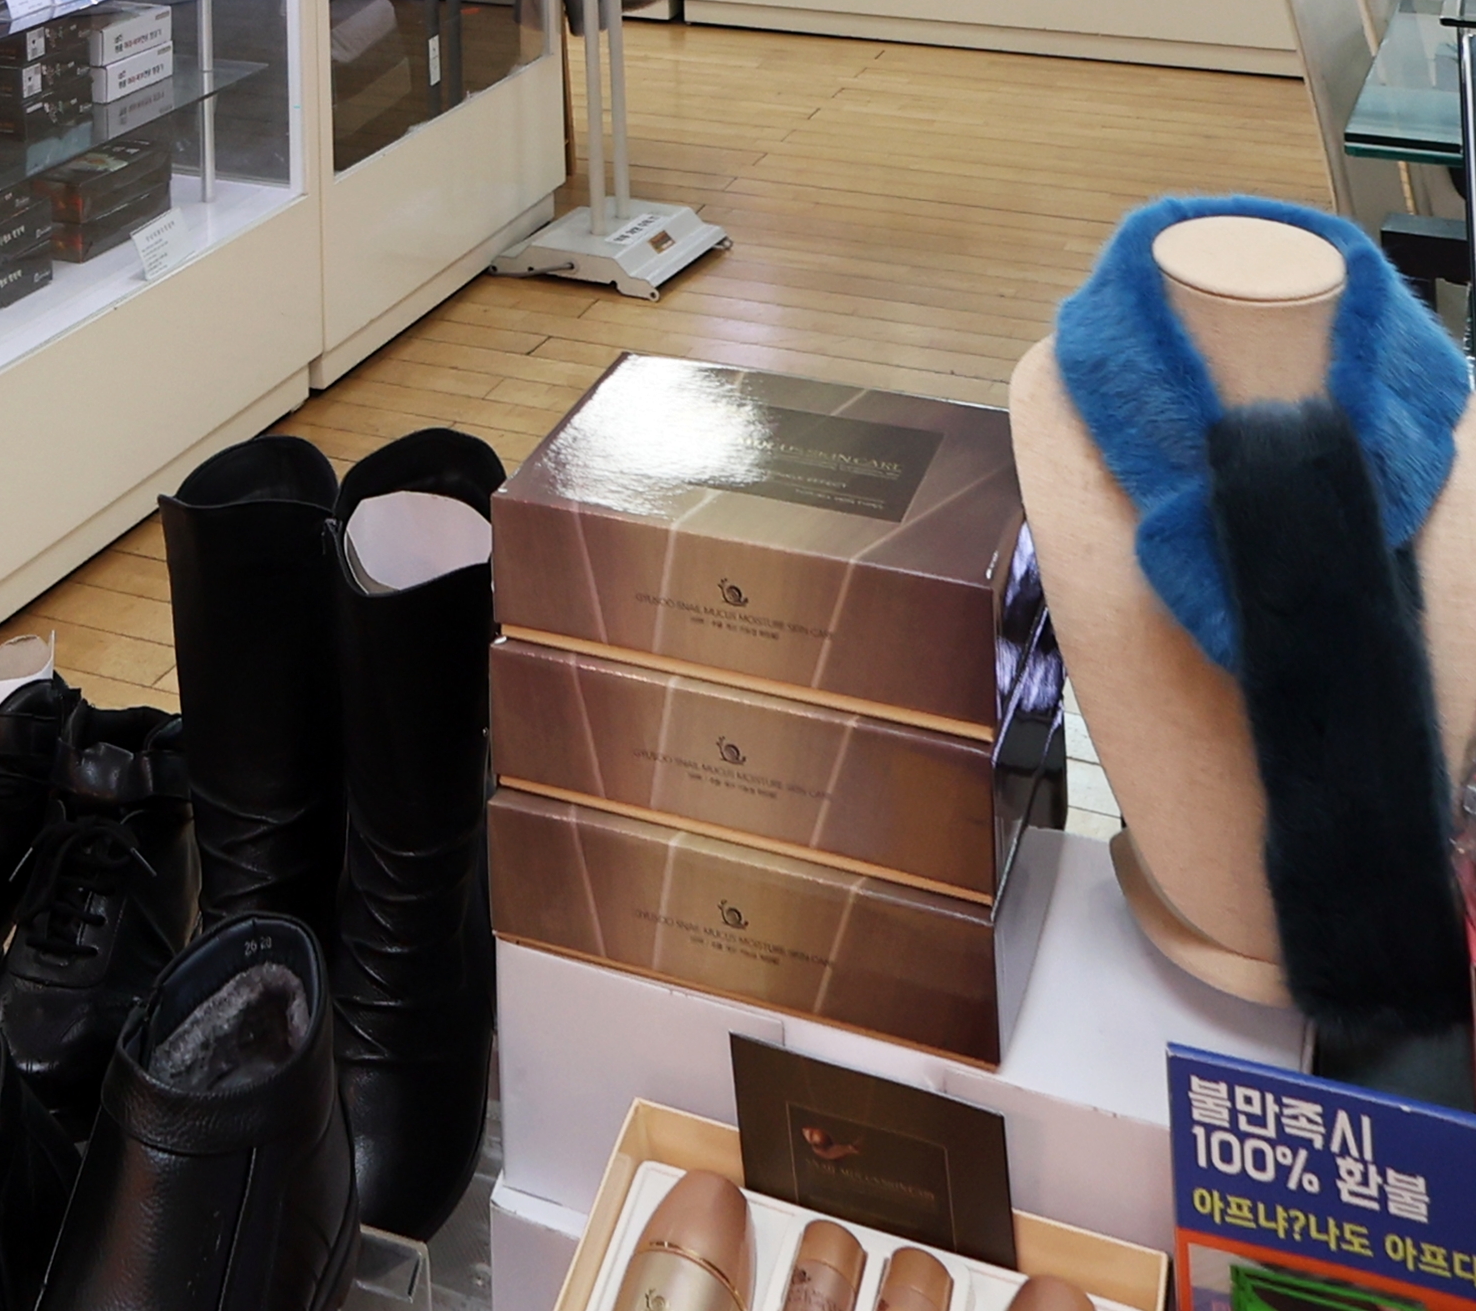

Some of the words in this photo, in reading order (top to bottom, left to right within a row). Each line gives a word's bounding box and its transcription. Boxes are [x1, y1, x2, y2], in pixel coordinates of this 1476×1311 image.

[676, 599, 701, 614] SNAIL
[704, 605, 737, 621] MUCUS
[738, 612, 785, 629] MOISTURE
[1188, 1074, 1374, 1162] 불만족시
[1192, 1125, 1321, 1195] 100%
[1336, 1155, 1431, 1224] 환불
[1192, 1187, 1374, 1258] 아프냐?나도
